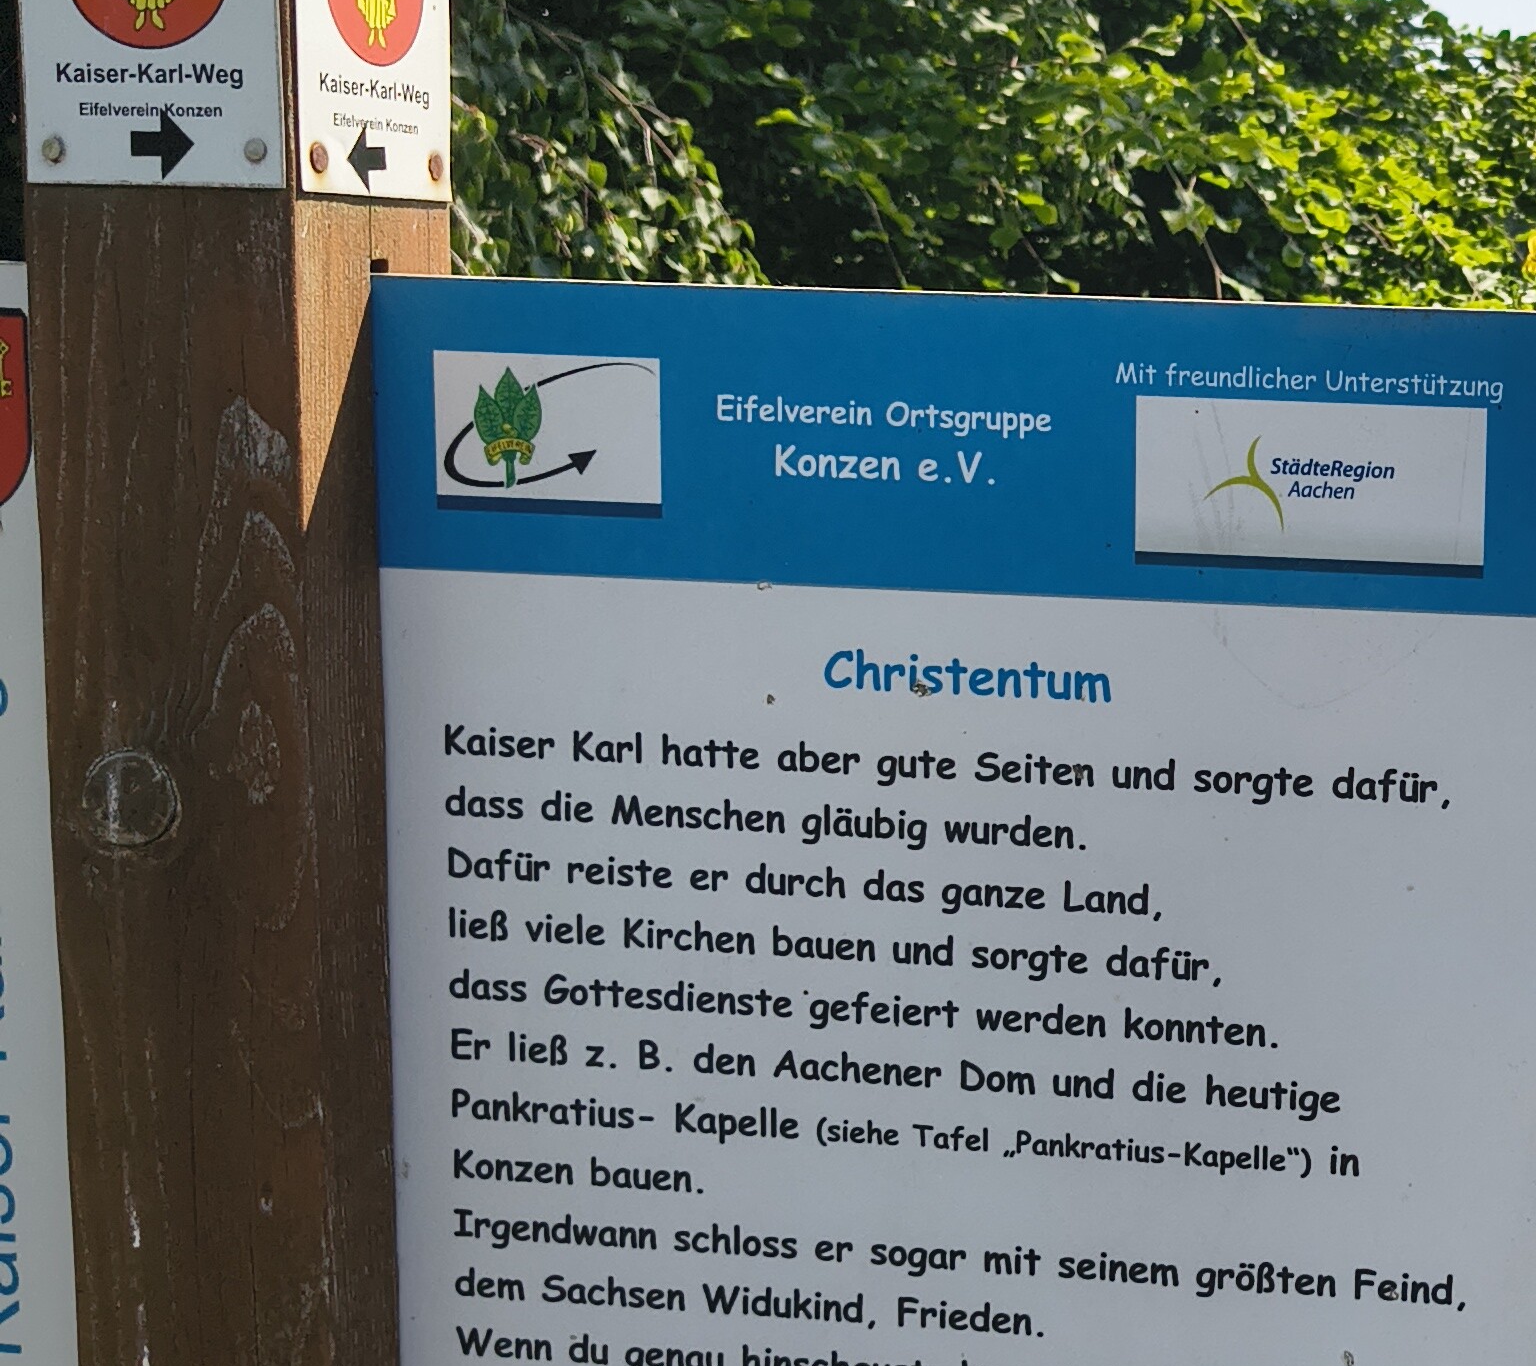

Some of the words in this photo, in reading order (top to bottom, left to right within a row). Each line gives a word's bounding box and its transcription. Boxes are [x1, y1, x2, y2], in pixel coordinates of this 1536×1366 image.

[56, 63, 243, 89] Kaiser-Karl-Weg
[320, 73, 429, 110] Kaiser-Karl-Weg
[80, 102, 158, 116] Eifelverein
[163, 103, 223, 118] Konzen
[386, 119, 418, 135] Konzen
[1116, 363, 1156, 384] Mit
[1166, 363, 1316, 390] freundlicher
[1326, 370, 1503, 403] Unterstützung
[717, 394, 872, 425] Eifelverein
[886, 402, 1051, 439] Ortsgruppe
[776, 444, 900, 480] Konzen
[1271, 458, 1394, 482] StädteRegion
[1288, 481, 1354, 499] Aachen
[824, 649, 1111, 703] Christentum
[445, 724, 555, 759] Kaiser
[573, 730, 642, 763] Karl
[662, 733, 759, 769] hatte
[778, 741, 860, 775] aber
[877, 750, 956, 786] gute
[975, 752, 1094, 787] Seiten
[1112, 758, 1175, 790] und
[1194, 767, 1313, 805] sorgte
[1332, 767, 1449, 809] dafür,
[445, 785, 523, 819] dass
[541, 790, 593, 823] die
[612, 795, 785, 834] Menschen
[802, 804, 927, 850] gläubig
[945, 815, 1086, 850] wurden.
[448, 847, 550, 882] Dafür
[568, 856, 672, 888] reiste
[690, 869, 728, 891] er
[746, 863, 846, 898] durch
[864, 869, 924, 903] das
[942, 884, 1045, 914] ganze
[1064, 880, 1161, 921] Land,
[449, 907, 508, 941] ließ
[525, 914, 605, 945] viele
[624, 918, 755, 955] Kirchen
[773, 925, 875, 962] bauen
[893, 935, 953, 966] und
[972, 945, 1088, 981] sorgte
[1106, 945, 1221, 987] dafür,
[449, 969, 526, 1002] dass
[544, 974, 792, 1017] Gottesdienste
[810, 992, 959, 1029] gefeiert
[976, 1003, 1106, 1038] werden
[1125, 1007, 1277, 1048] konnten.
[451, 1028, 490, 1060] Er
[509, 1031, 567, 1066] ließ
[586, 1046, 616, 1068] z.
[639, 1040, 672, 1072] B.
[694, 1043, 755, 1076] den
[773, 1050, 941, 1088] Aachener
[961, 1060, 1035, 1095] Dom
[1053, 1068, 1114, 1099] und
[1132, 1071, 1186, 1103] die
[1206, 1074, 1340, 1121] heutige
[452, 1088, 654, 1128] Pankratius-
[676, 1103, 799, 1144] Kapelle
[817, 1117, 899, 1146] (siehe
[913, 1124, 988, 1151] Tafel
[1330, 1146, 1359, 1176] in
[454, 1149, 573, 1185] Konzen
[591, 1156, 703, 1194] bauen.
[454, 1209, 657, 1250] Irgendwann
[674, 1223, 797, 1259] schloss
[815, 1241, 853, 1262] er
[871, 1244, 966, 1277] sogar
[984, 1246, 1041, 1276] mit
[1058, 1252, 1179, 1287] seinem
[1196, 1262, 1336, 1297] größten
[1355, 1269, 1465, 1311] Feind,
[455, 1267, 525, 1301] dem
[542, 1275, 685, 1311] Sachsen
[703, 1283, 875, 1329] Widukind,
[898, 1297, 1044, 1337] Frieden.
[456, 1326, 552, 1361] Wenn
[569, 1334, 608, 1365] du
